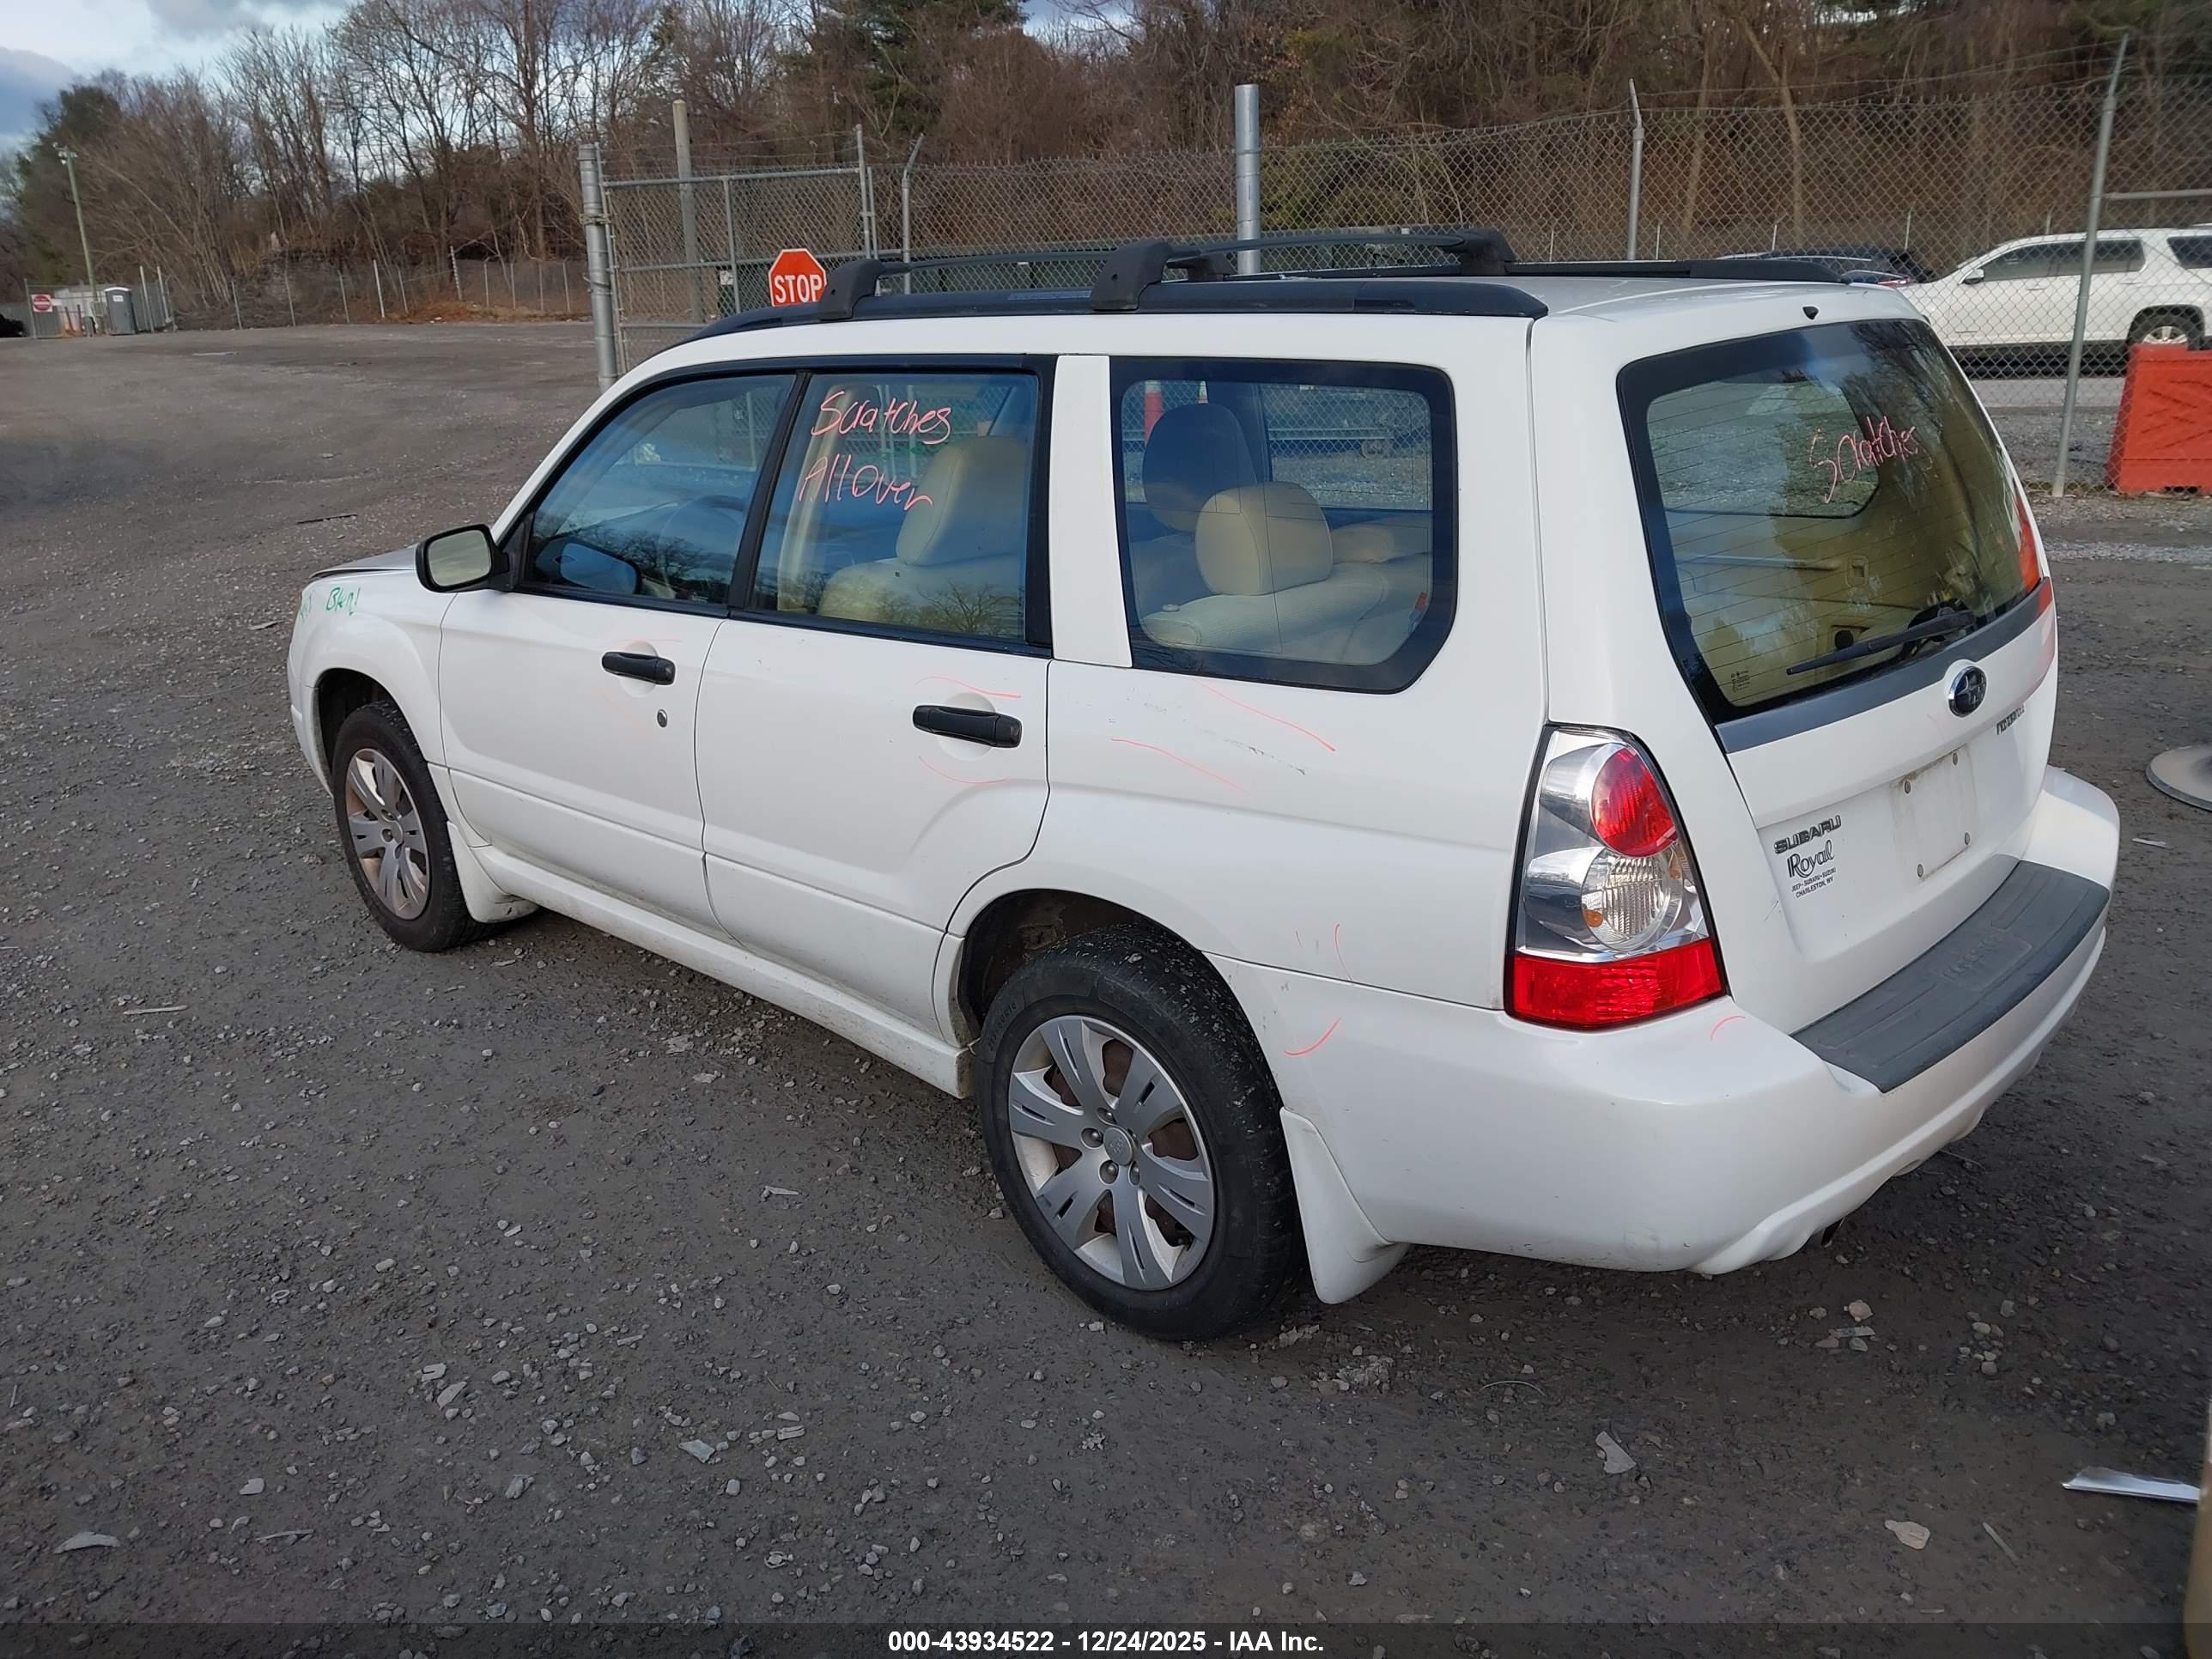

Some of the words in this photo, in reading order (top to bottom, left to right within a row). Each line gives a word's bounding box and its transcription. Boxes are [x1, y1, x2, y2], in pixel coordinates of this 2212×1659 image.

[774, 274, 823, 303] STOP
[1774, 815, 1842, 854] SUBARU
[1787, 839, 1835, 878] Royal
